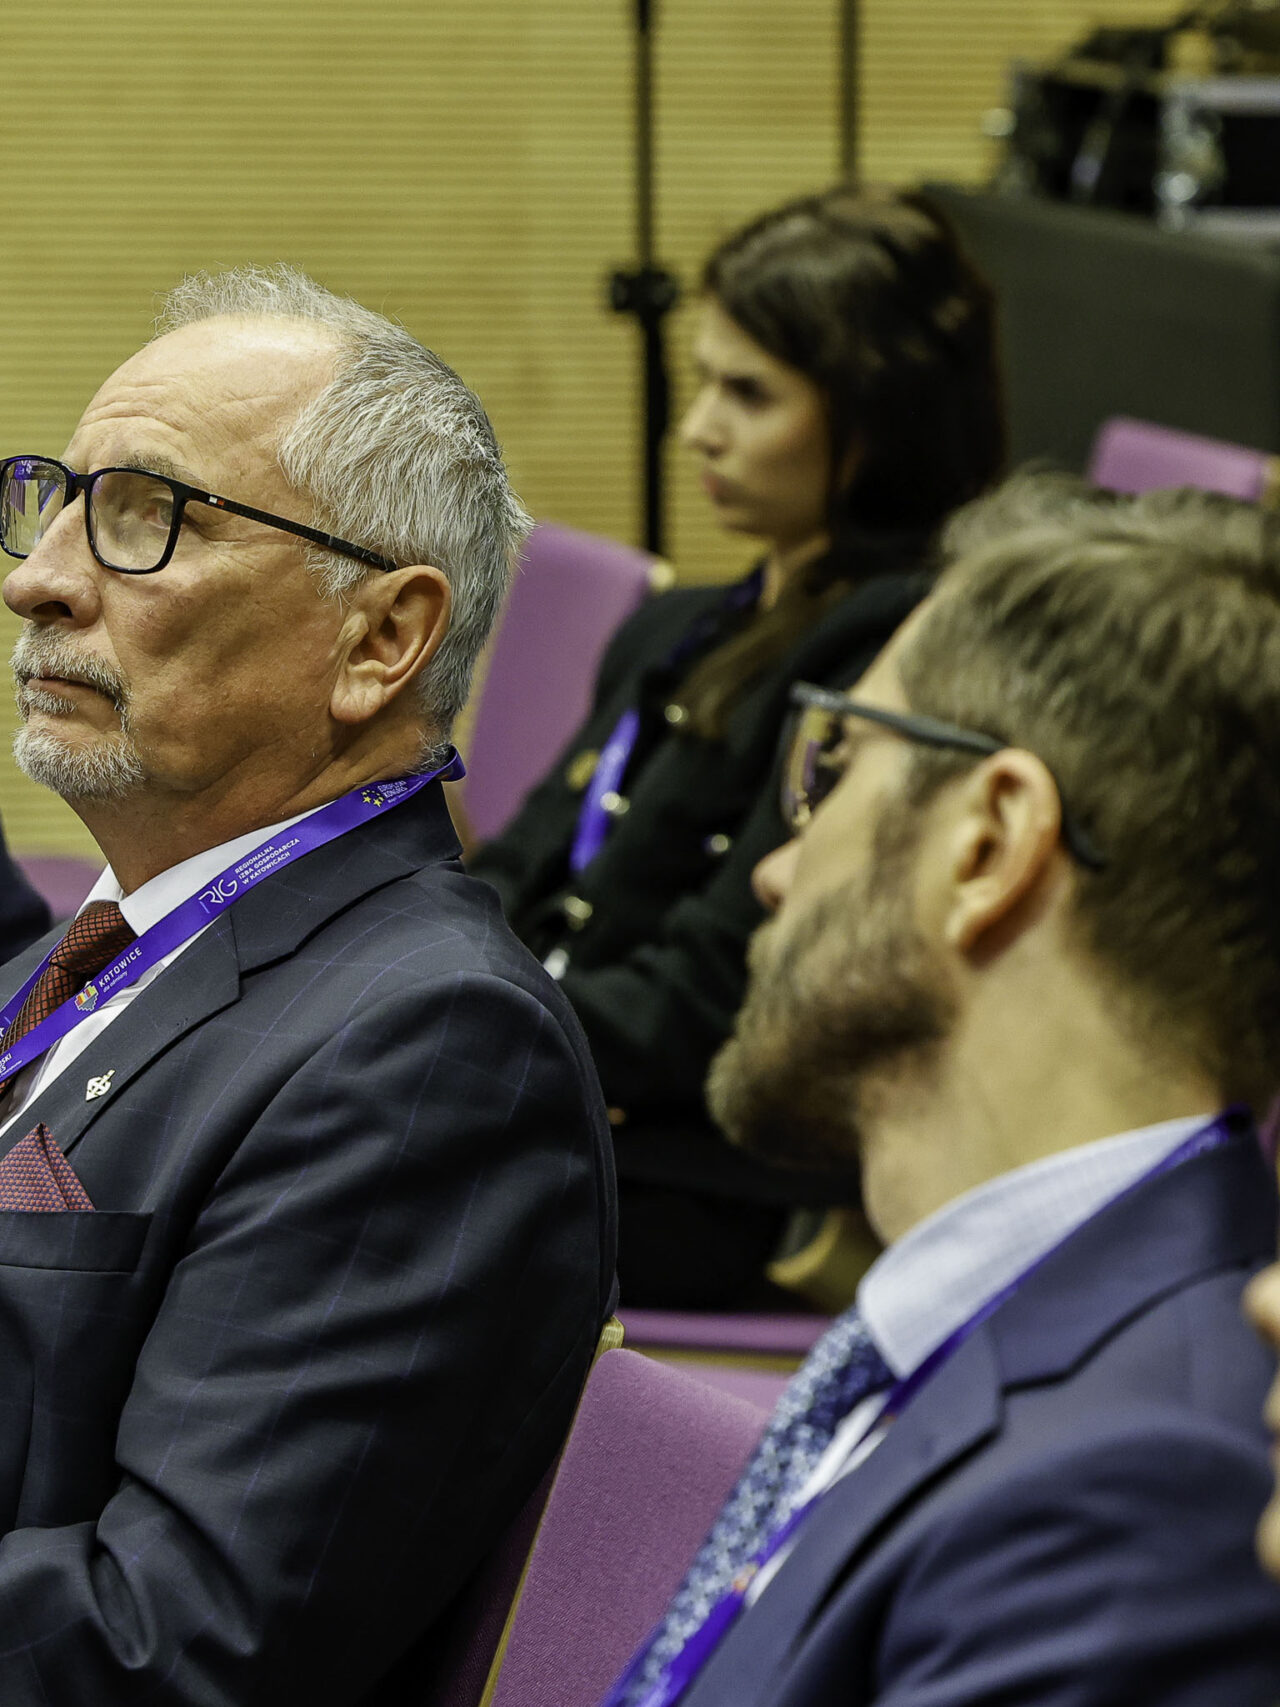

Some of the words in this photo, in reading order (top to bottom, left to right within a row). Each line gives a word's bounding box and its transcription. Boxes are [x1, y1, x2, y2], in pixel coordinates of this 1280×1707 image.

[234, 845, 274, 874] REGIONALNA
[238, 867, 254, 879] IZBA
[253, 838, 300, 868] GOSPODARCZA
[249, 851, 291, 880] KATOWICACH
[198, 879, 238, 904] RIG
[98, 947, 142, 987] KATOWICE
